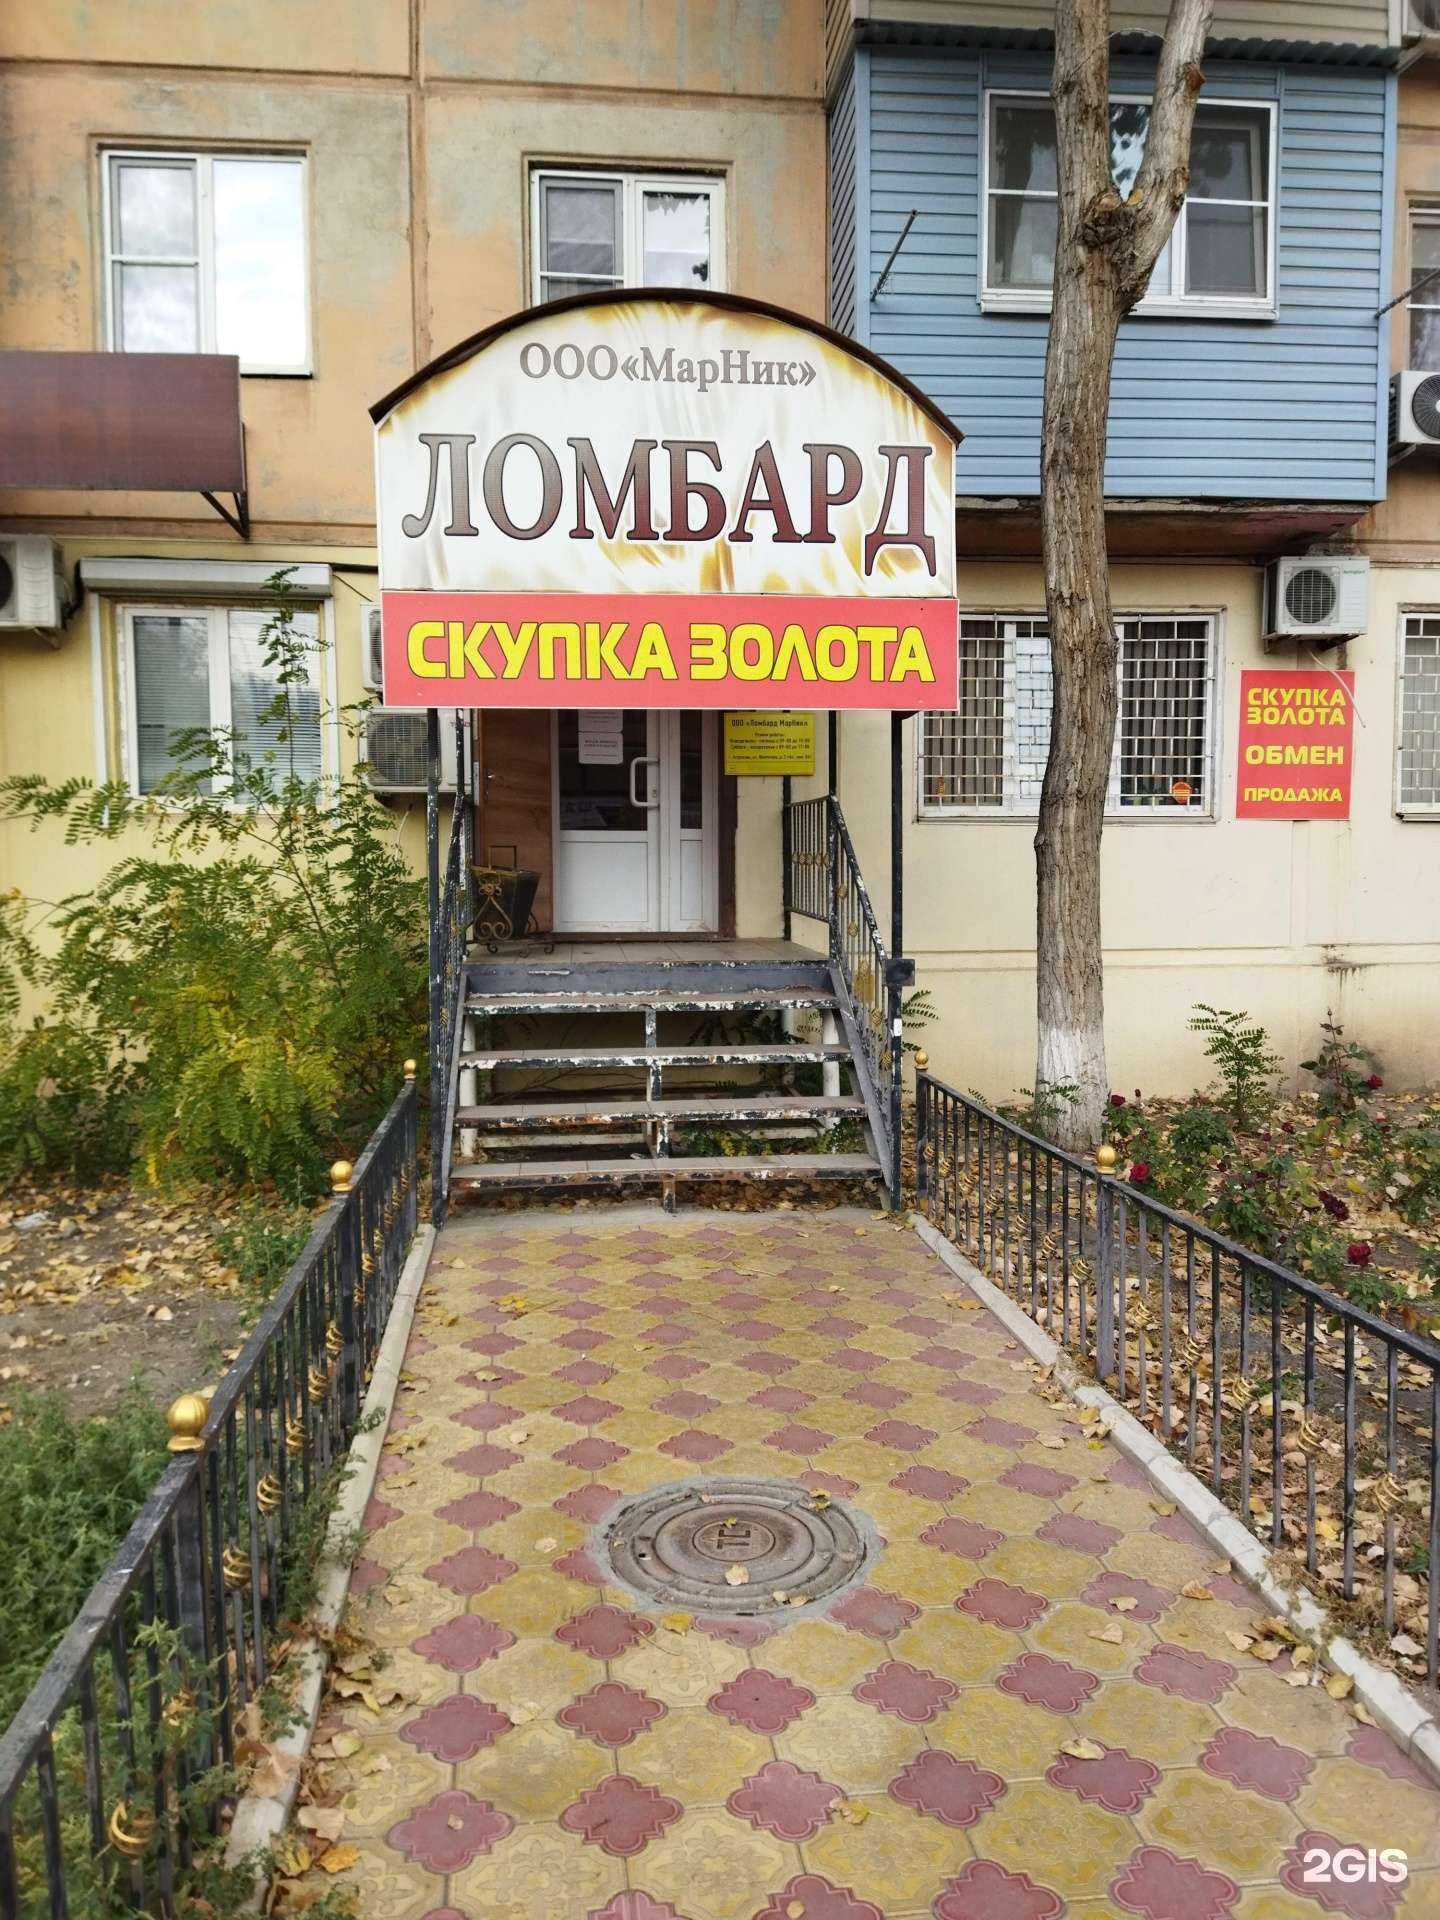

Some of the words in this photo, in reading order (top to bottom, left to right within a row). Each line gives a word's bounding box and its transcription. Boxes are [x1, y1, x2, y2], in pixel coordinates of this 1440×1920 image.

[401, 432, 937, 577] ЛОМБАРД
[406, 620, 679, 681] СКУПКА
[688, 622, 937, 684] ЗОЛОТА
[1247, 687, 1347, 706] СКУПКА
[1246, 706, 1346, 726] ЗОЛОТА
[1245, 745, 1345, 765] ОБМЕН
[1243, 787, 1343, 802] ПРОДАЖА
